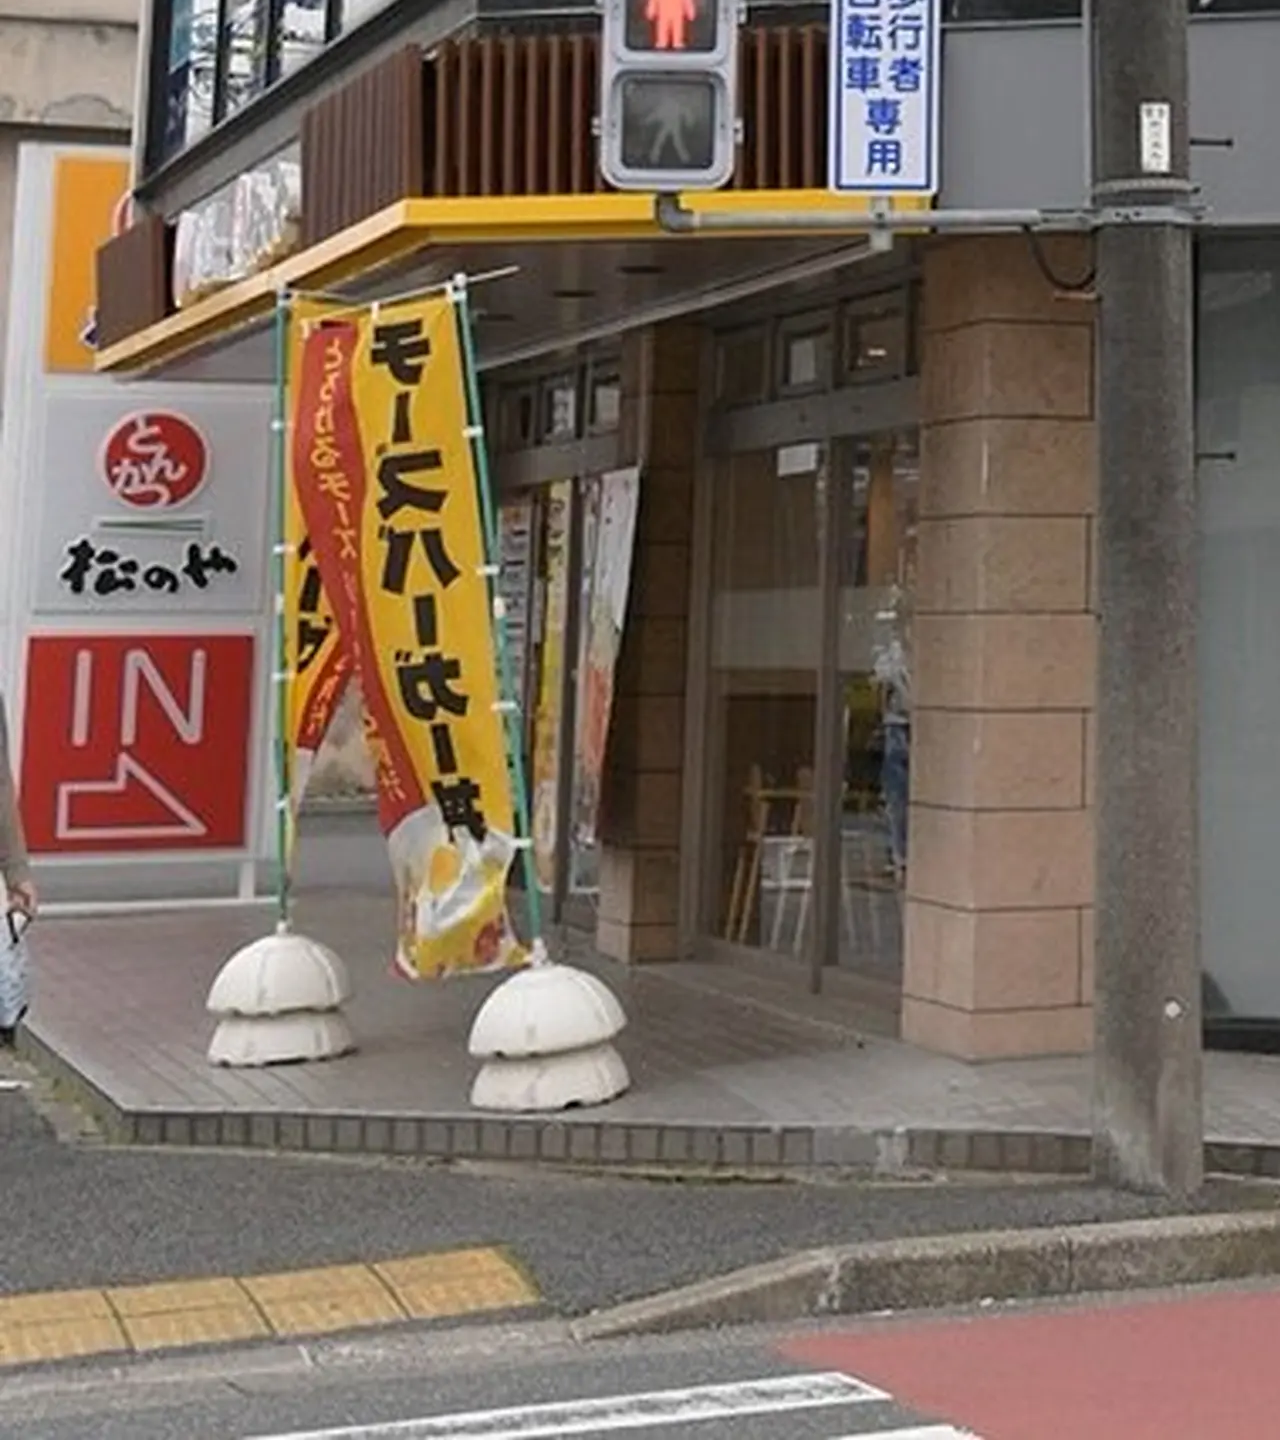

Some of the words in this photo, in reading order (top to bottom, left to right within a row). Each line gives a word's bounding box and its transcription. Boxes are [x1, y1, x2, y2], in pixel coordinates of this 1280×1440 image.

[865, 97, 903, 177] 専用
[61, 539, 238, 596] 松のや
[72, 648, 206, 747] IN
